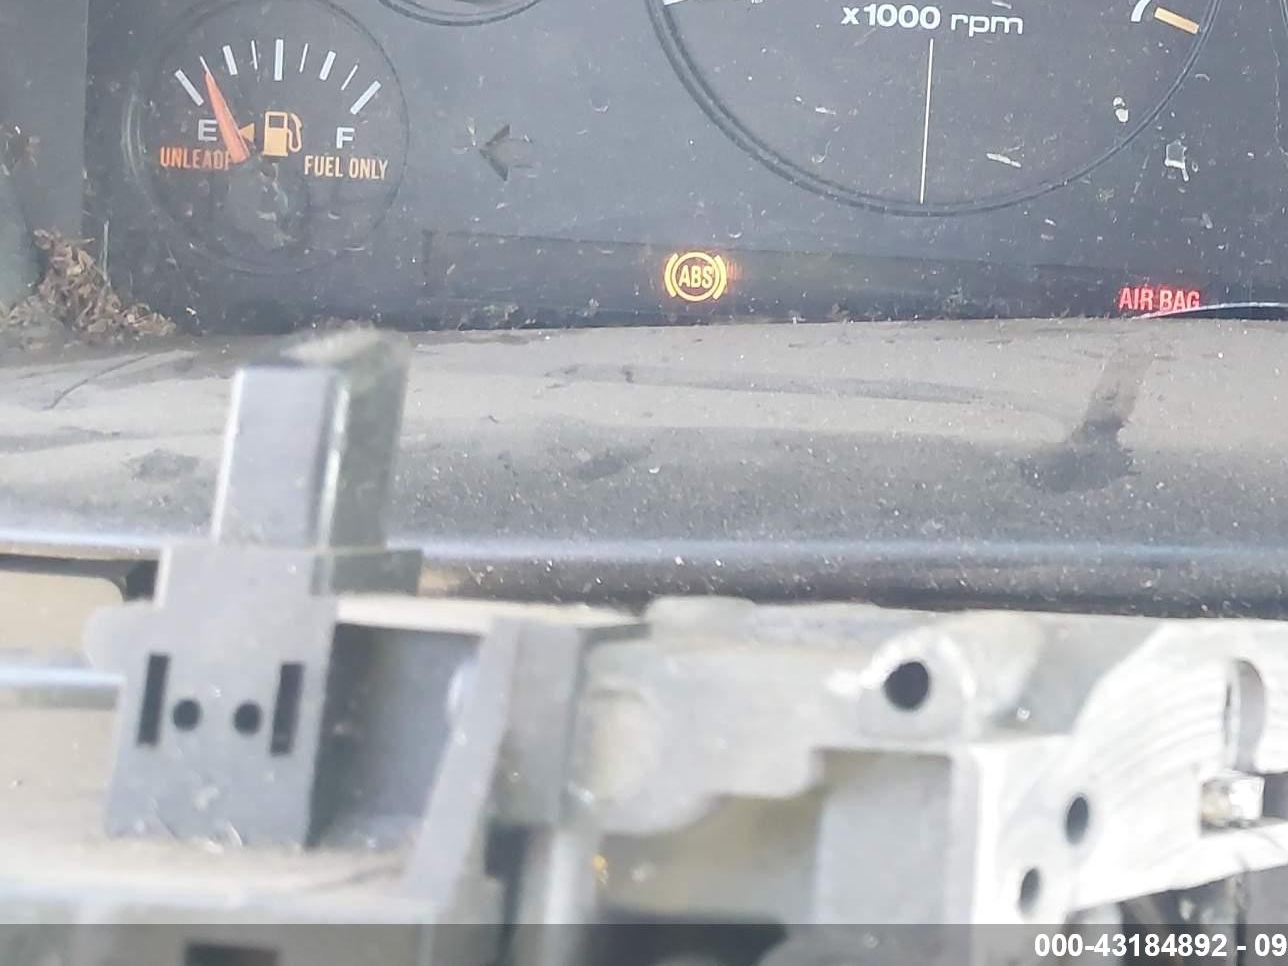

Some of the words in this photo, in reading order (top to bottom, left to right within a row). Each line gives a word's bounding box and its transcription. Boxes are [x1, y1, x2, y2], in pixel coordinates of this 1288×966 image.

[840, 3, 941, 31] x1000
[950, 12, 1024, 36] rpm
[198, 119, 218, 142] E
[336, 126, 355, 150] F
[160, 146, 232, 171] UNLEAD
[304, 154, 343, 178] FUEL
[349, 156, 389, 180] ONLY
[678, 264, 715, 289] ABS
[1119, 287, 1154, 311] AIR
[1160, 289, 1200, 311] BAG
